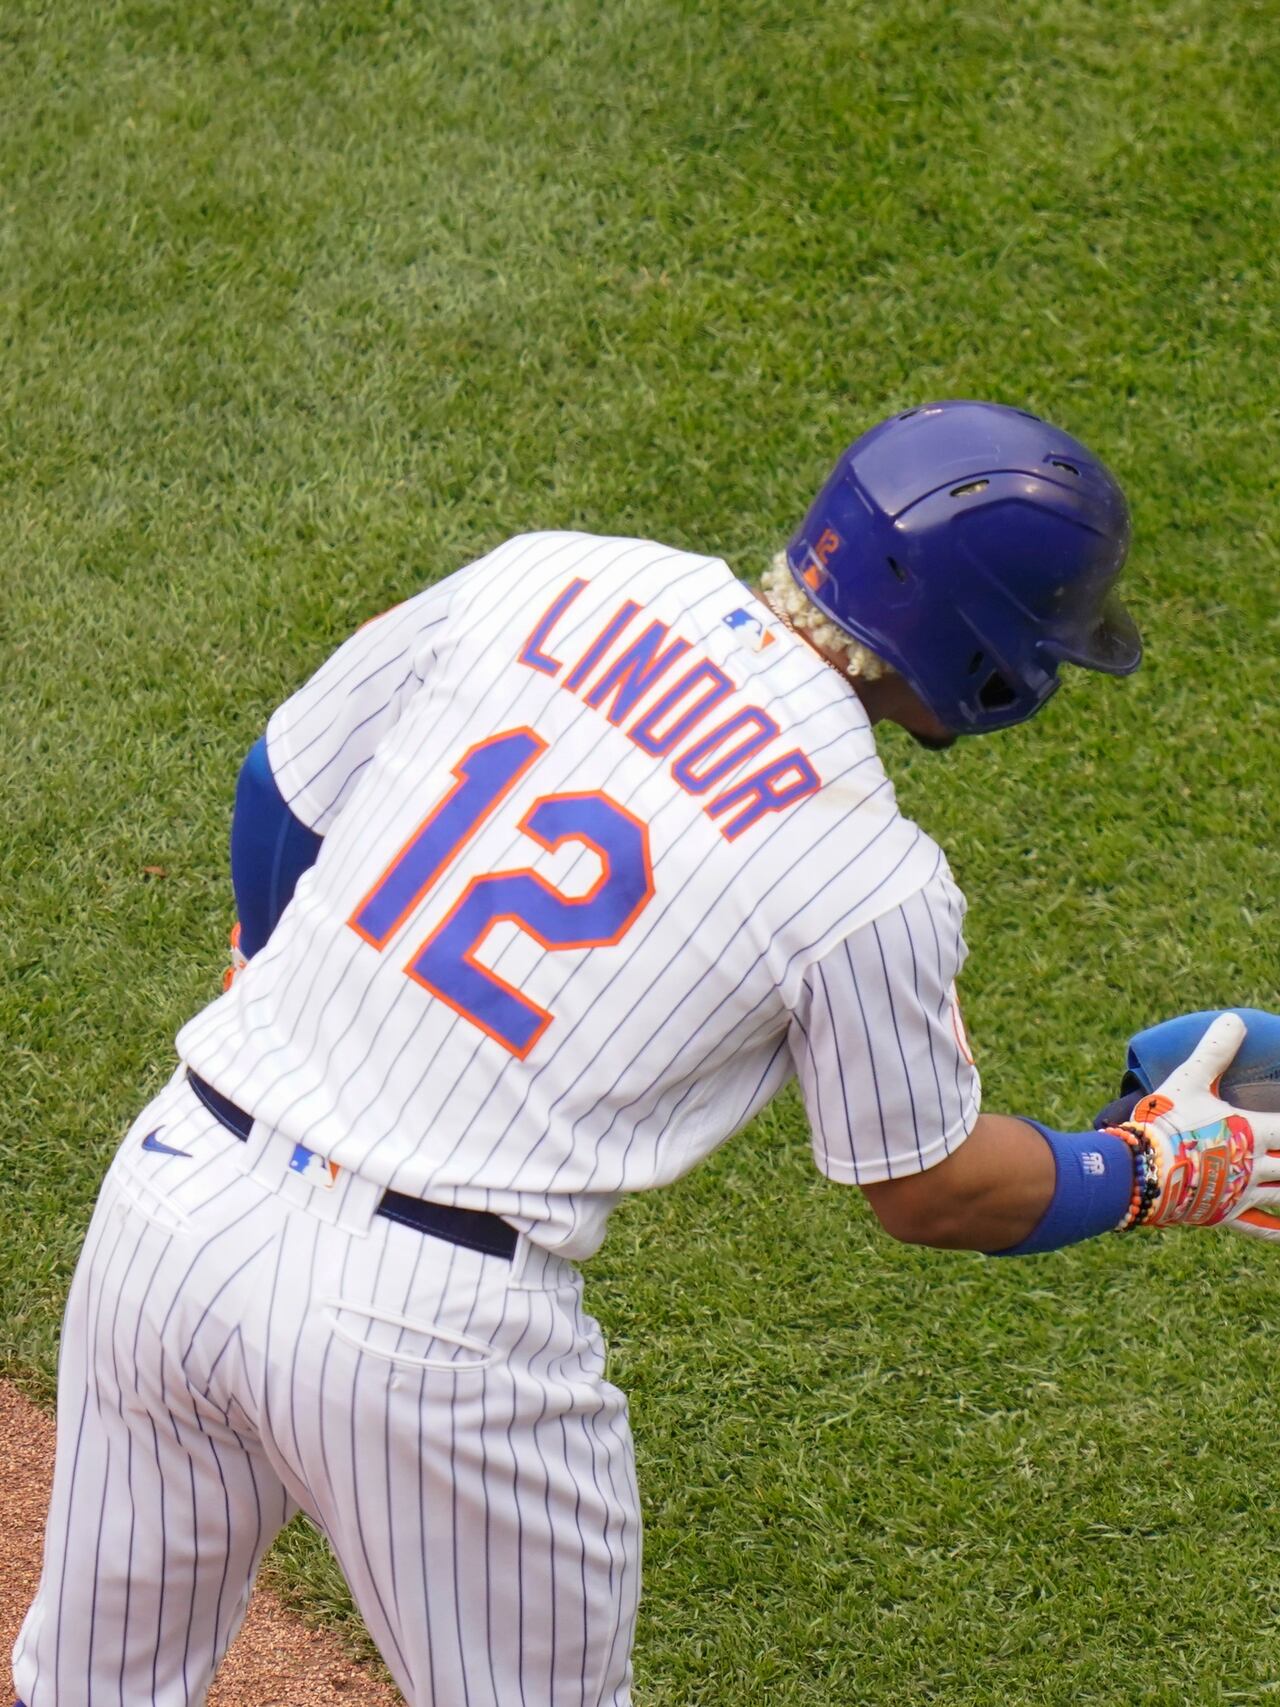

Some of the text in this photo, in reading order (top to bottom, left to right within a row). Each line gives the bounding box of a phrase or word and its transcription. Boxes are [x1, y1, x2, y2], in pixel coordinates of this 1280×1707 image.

[815, 528, 840, 565] 12
[518, 577, 821, 842] LINDOR
[347, 726, 655, 1060] 12
